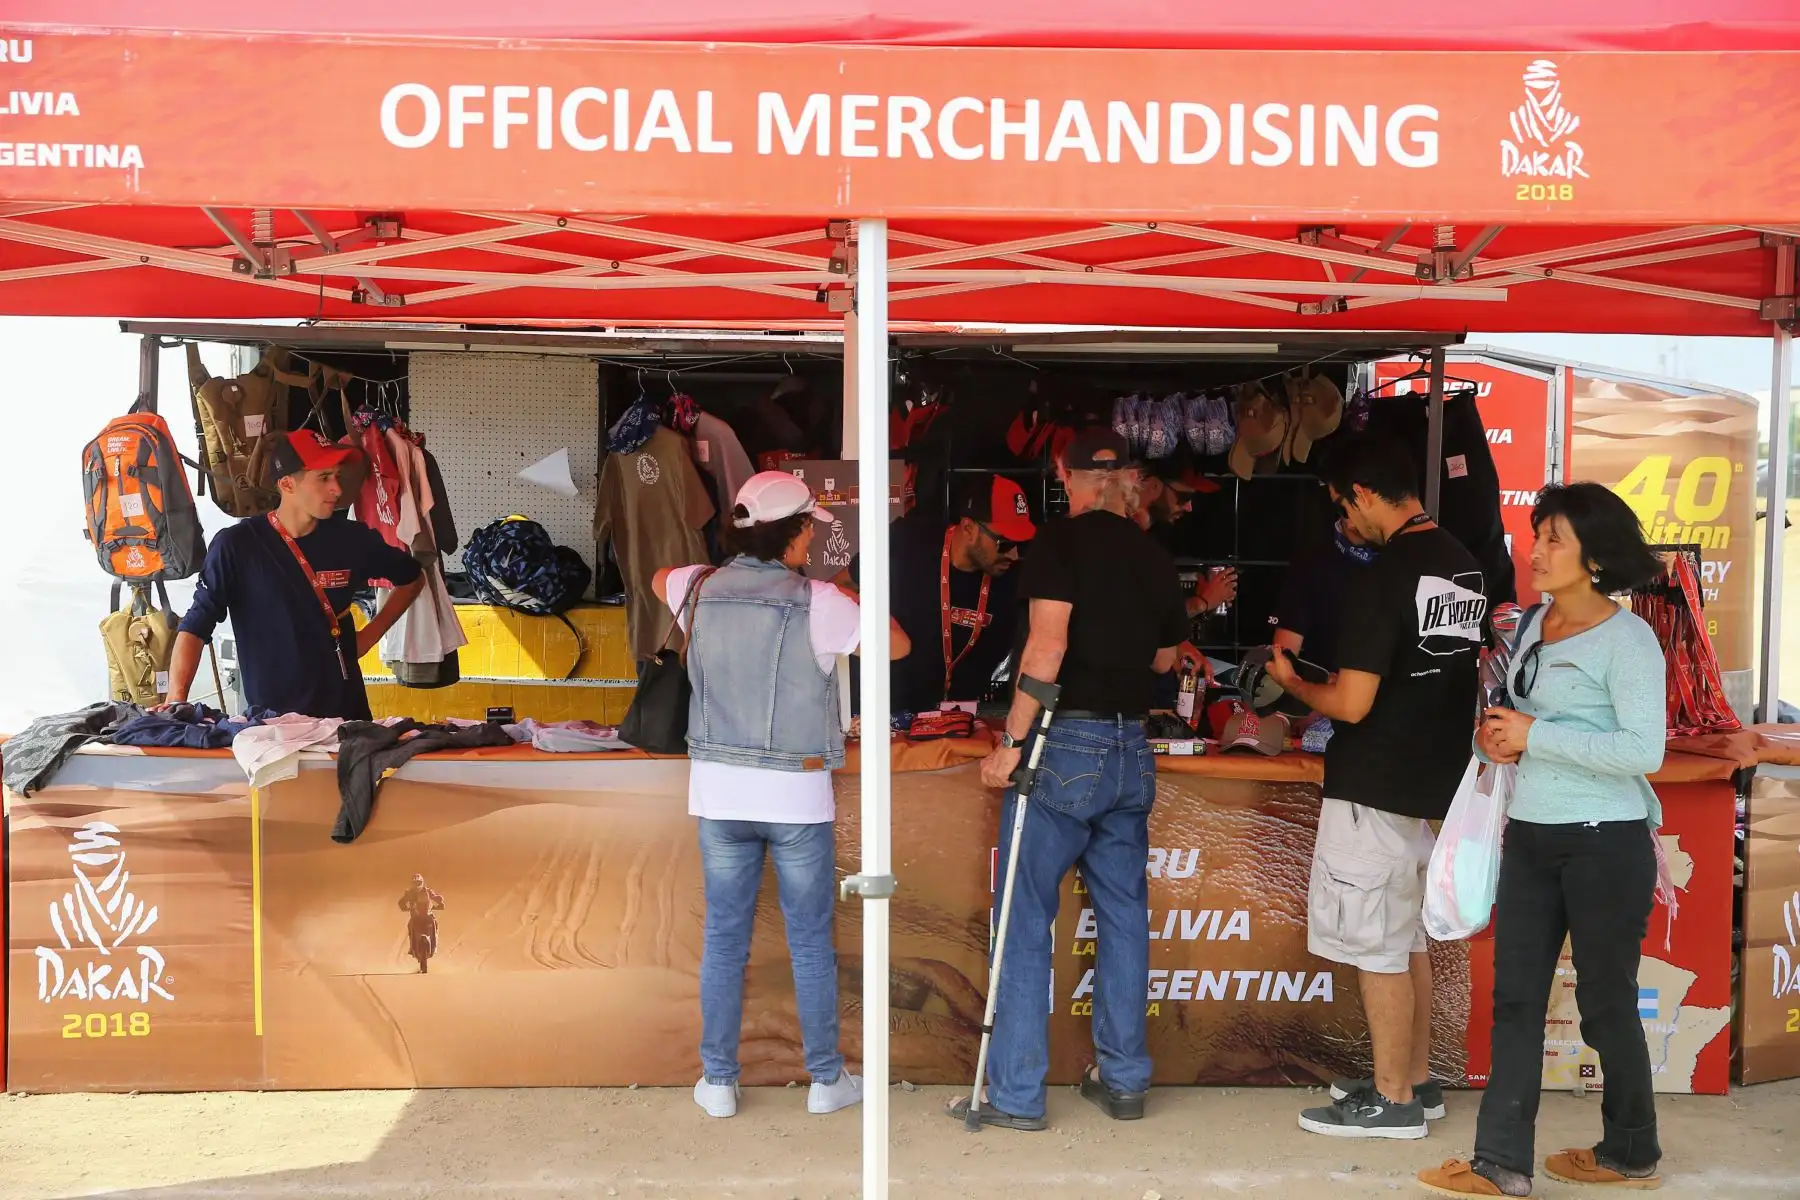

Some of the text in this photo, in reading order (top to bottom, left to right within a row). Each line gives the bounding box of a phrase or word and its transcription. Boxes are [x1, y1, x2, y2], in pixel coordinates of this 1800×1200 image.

[380, 82, 1439, 168] OFFICIAL MERCHANDISING
[1500, 139, 1590, 180] DAKAR
[1516, 184, 1574, 201] 2018
[1612, 455, 1732, 523] 40
[823, 551, 851, 567] DAKAR
[1074, 908, 1250, 941] BLIVIA
[35, 946, 174, 1003] DAKAR
[1071, 968, 1334, 1002] AGENTINA
[62, 1012, 151, 1038] 2018
